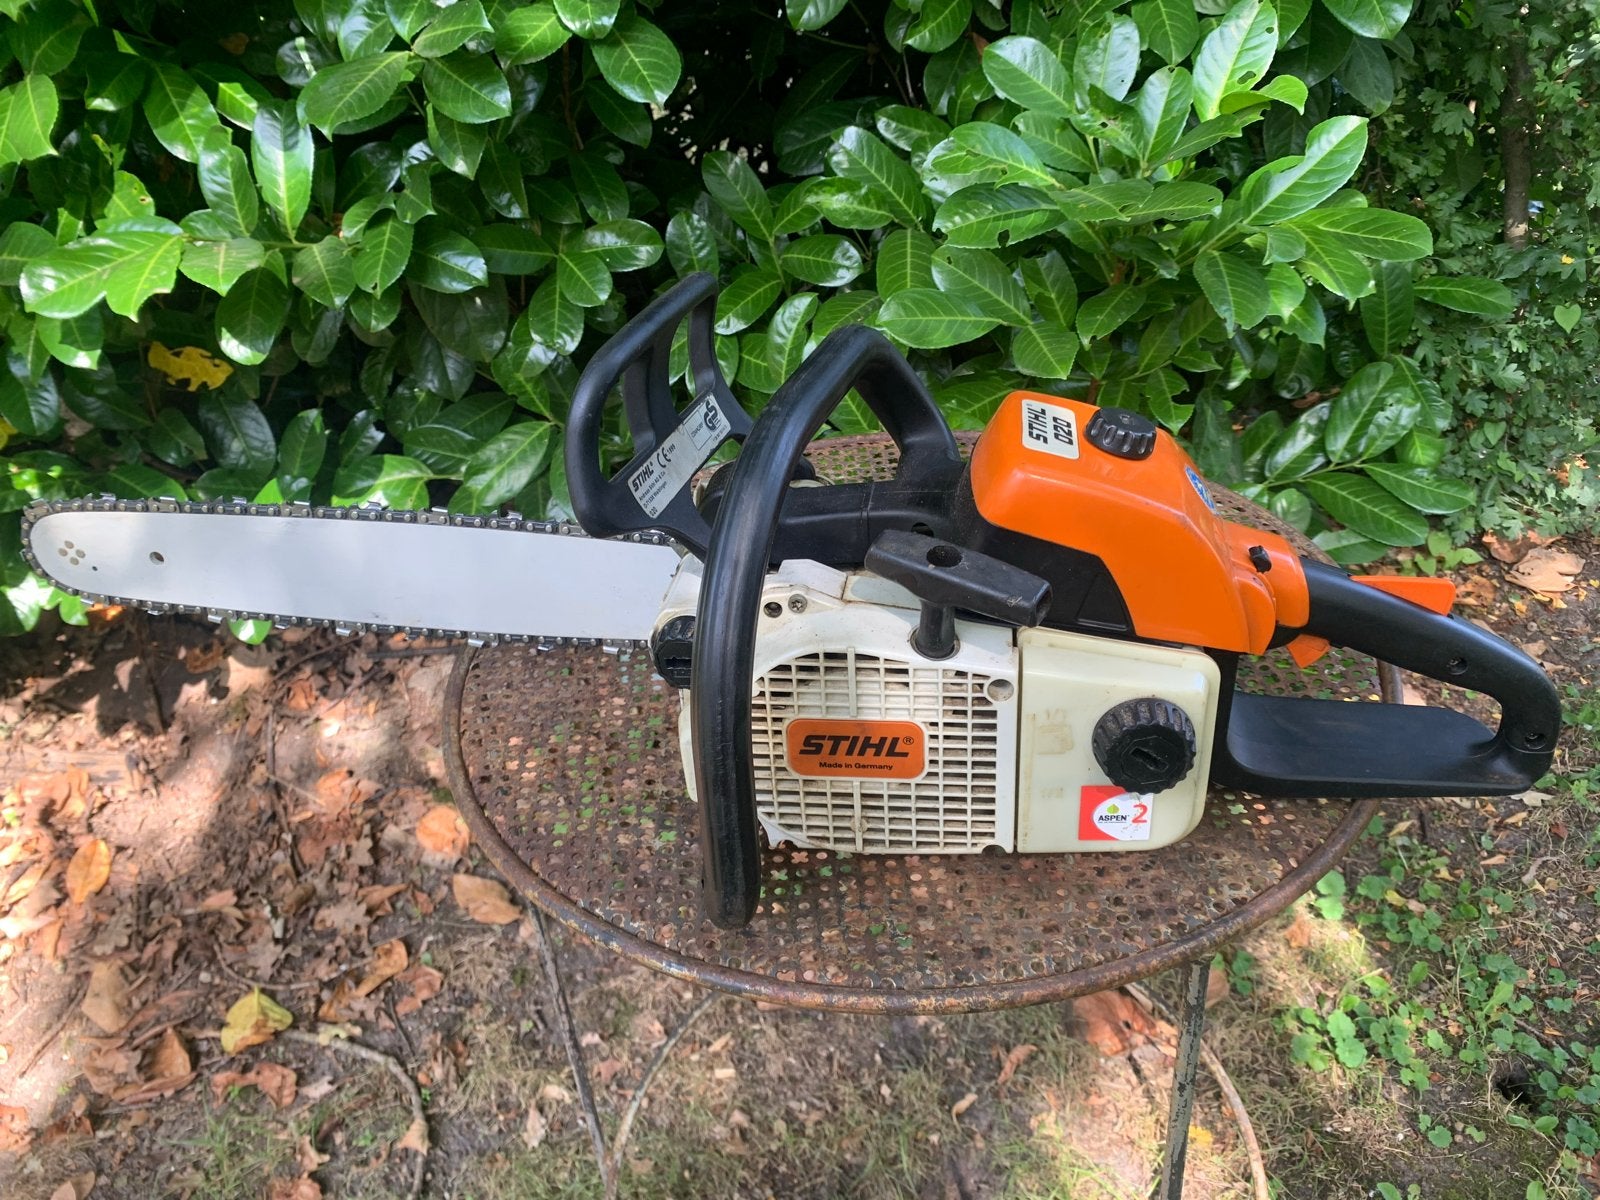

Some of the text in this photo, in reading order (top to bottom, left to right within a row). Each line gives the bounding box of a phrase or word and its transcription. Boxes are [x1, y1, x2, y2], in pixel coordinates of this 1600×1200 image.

[1027, 407, 1048, 444] STIHL
[1052, 416, 1073, 445] 020
[632, 464, 654, 492] STIHL
[819, 761, 893, 771] Made in Germany
[1132, 803, 1148, 823] 2
